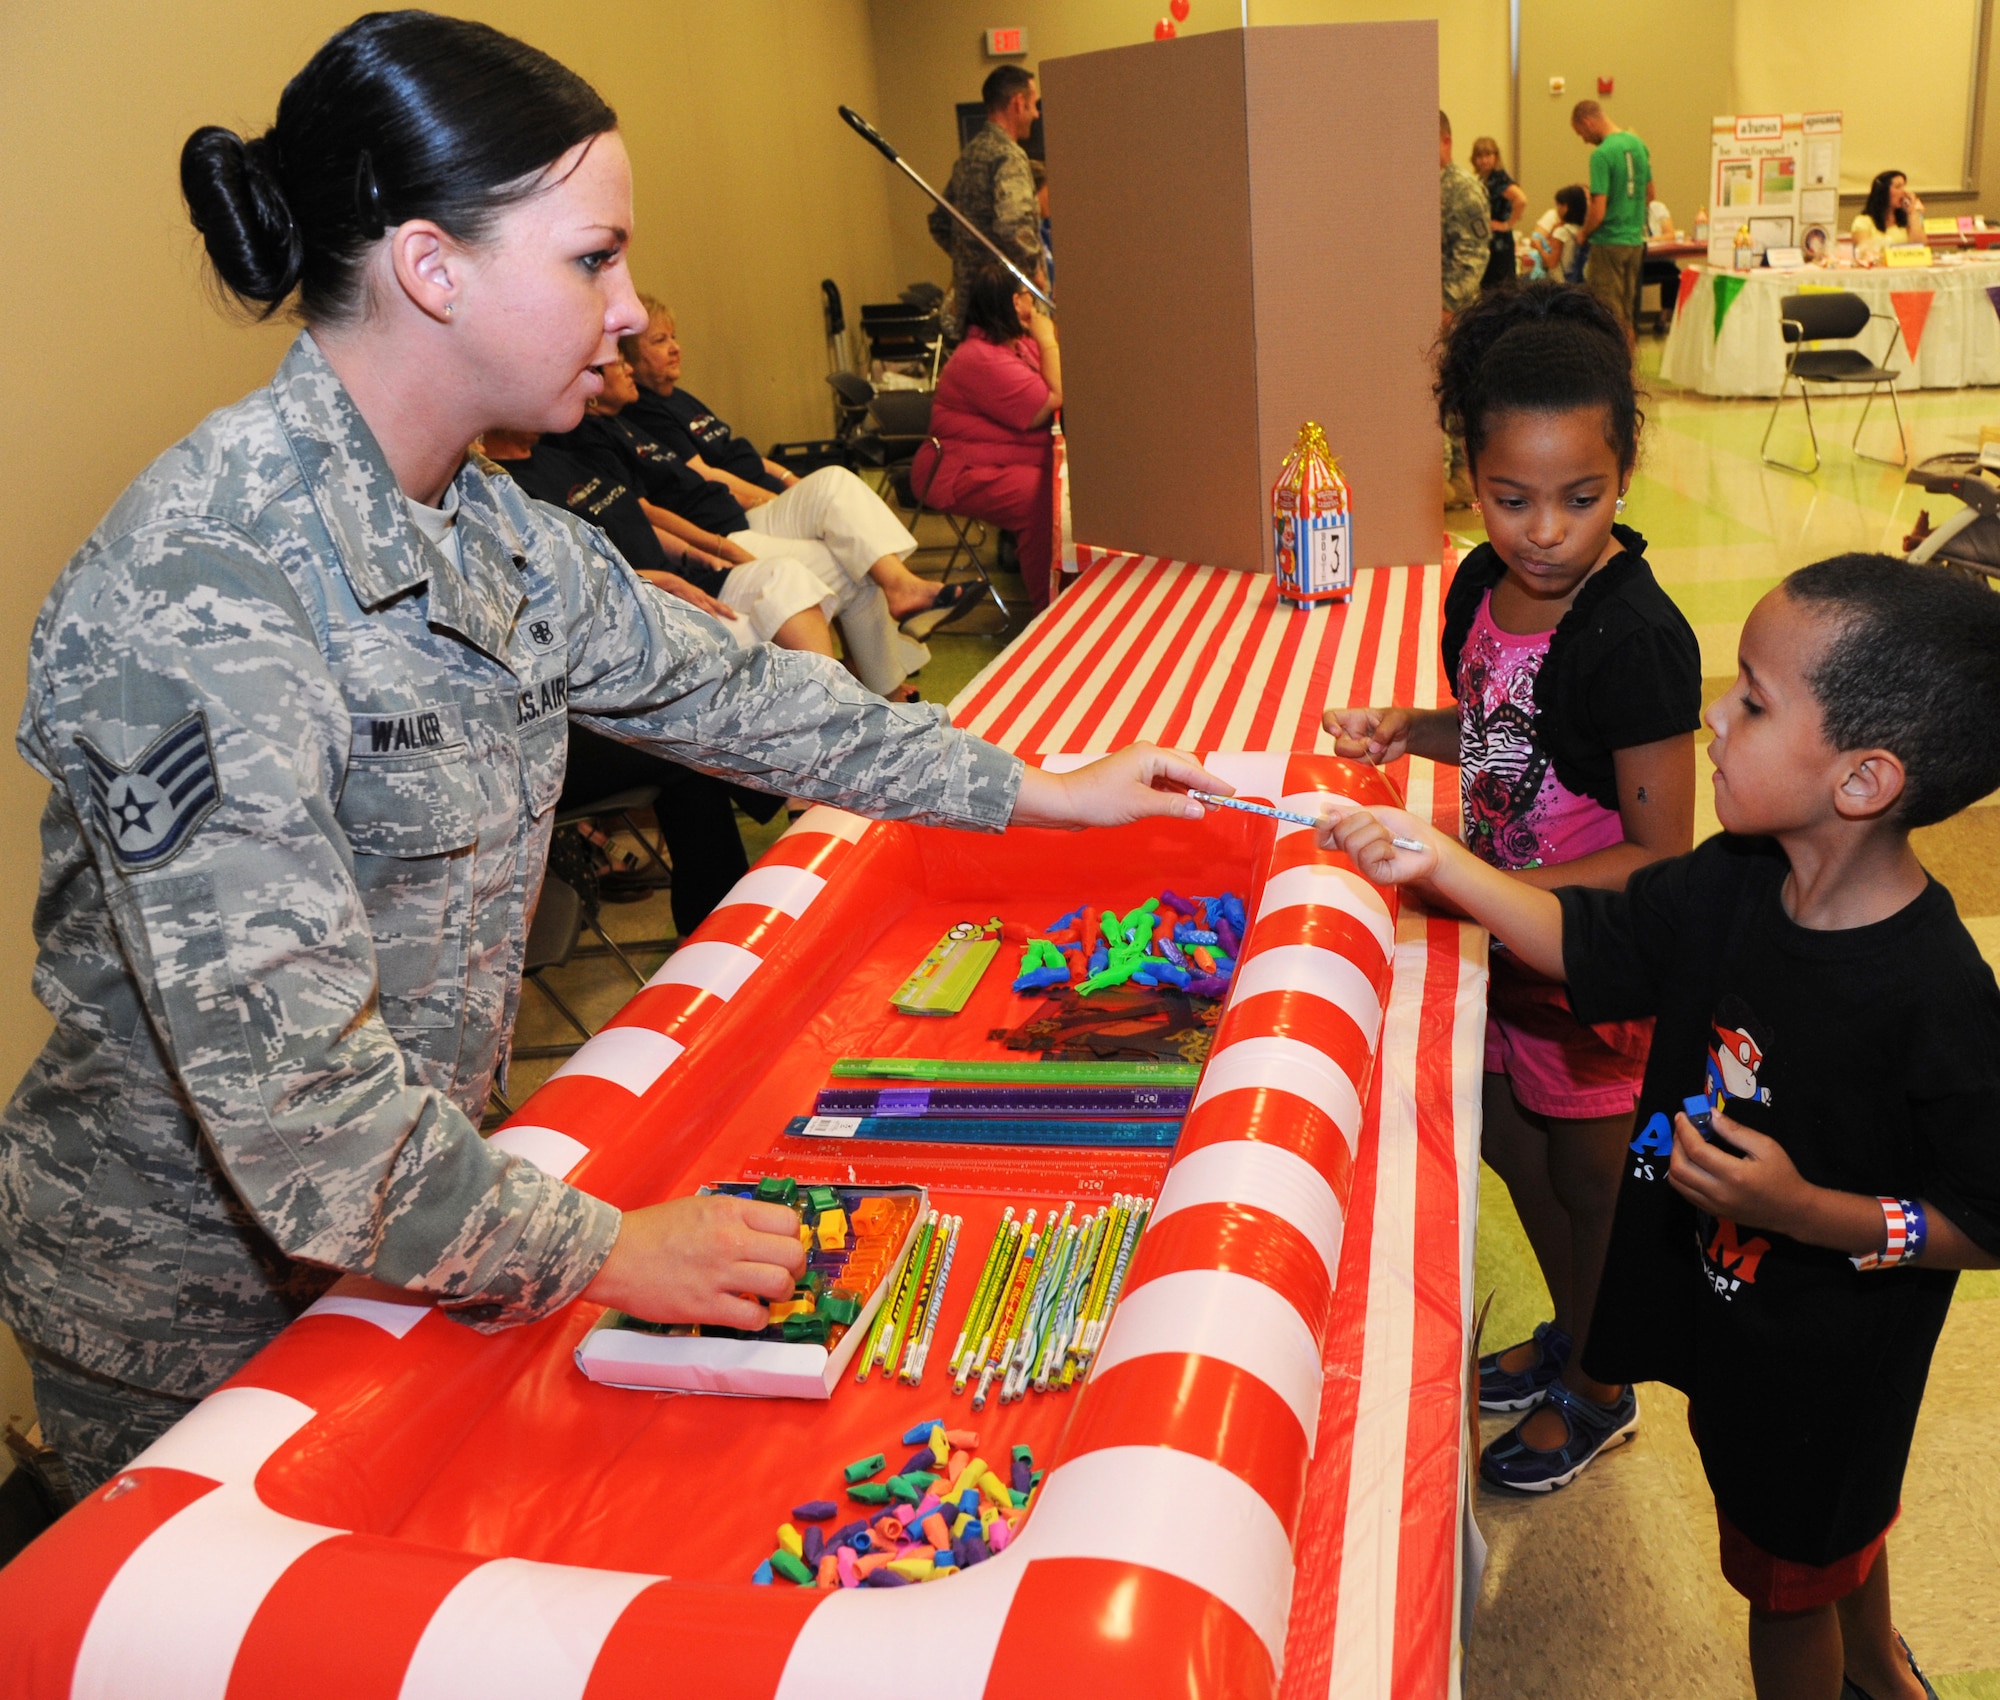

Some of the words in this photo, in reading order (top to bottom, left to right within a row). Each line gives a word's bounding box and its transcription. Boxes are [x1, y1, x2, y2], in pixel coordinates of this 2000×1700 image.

[994, 29, 1020, 53] EXIT
[371, 712, 444, 752] WALKER
[1633, 1157, 1655, 1181] is
